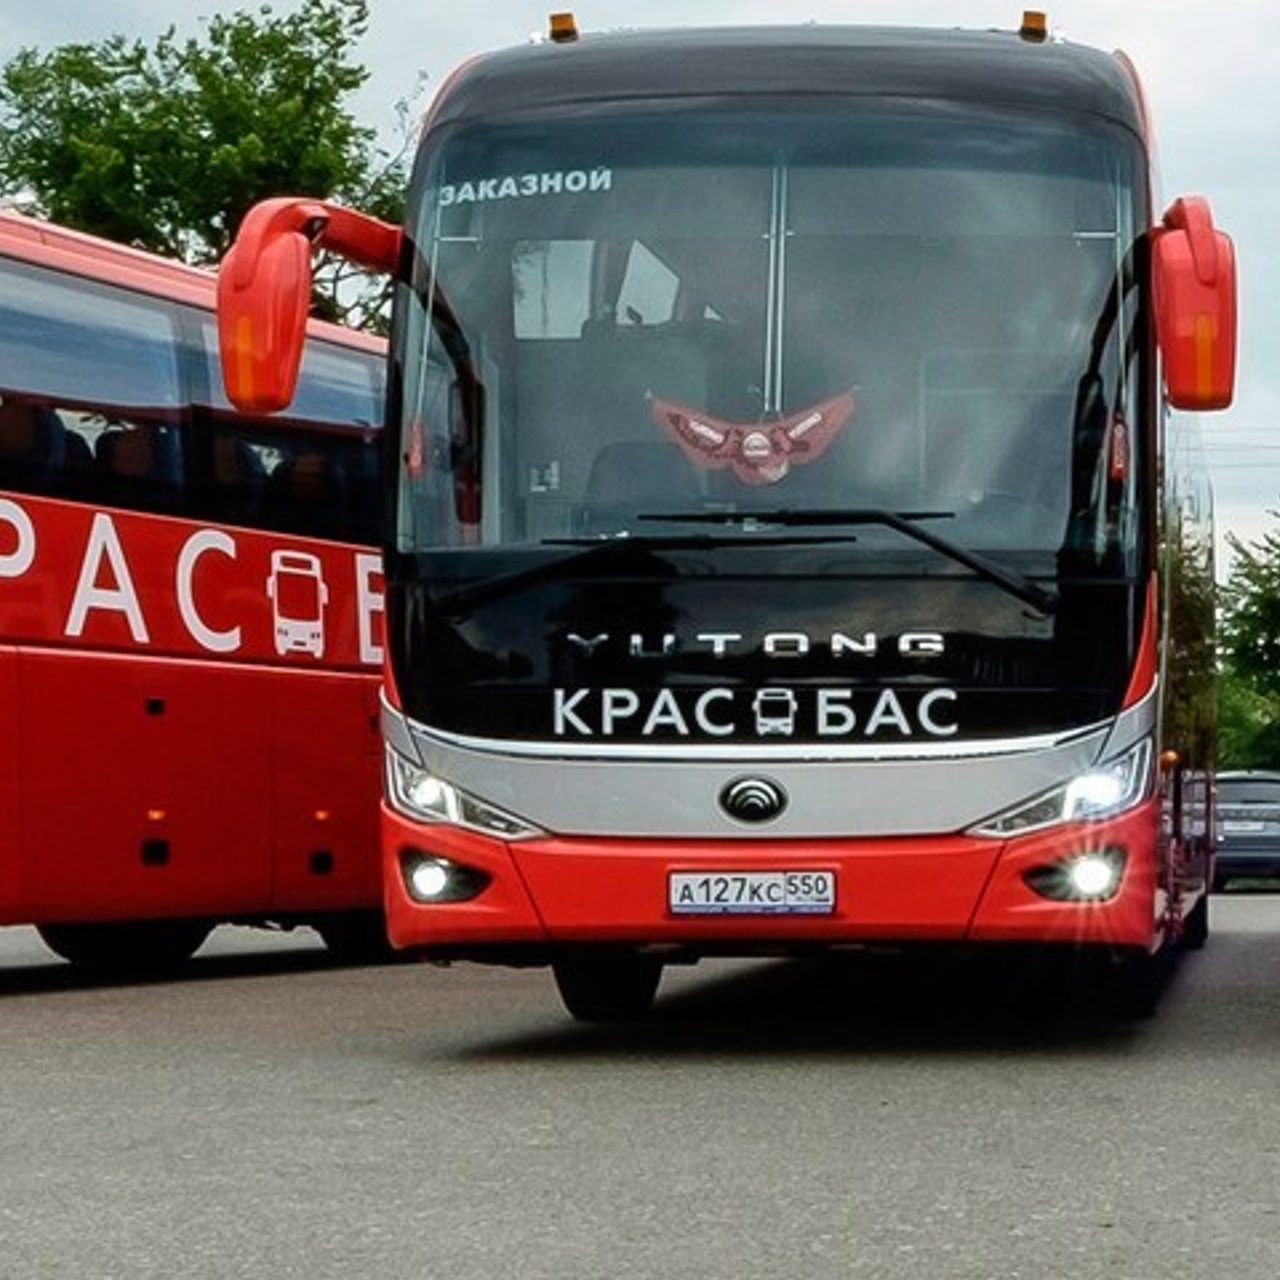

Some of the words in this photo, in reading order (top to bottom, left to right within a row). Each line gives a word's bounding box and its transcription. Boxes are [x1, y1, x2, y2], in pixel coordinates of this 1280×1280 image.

[439, 166, 612, 206] ЗАКАЗНОЙ
[566, 632, 945, 658] YUTONG
[552, 687, 736, 736] КРАС
[816, 687, 959, 736] БАС
[679, 877, 782, 902] А127КС
[786, 875, 828, 894] 550
